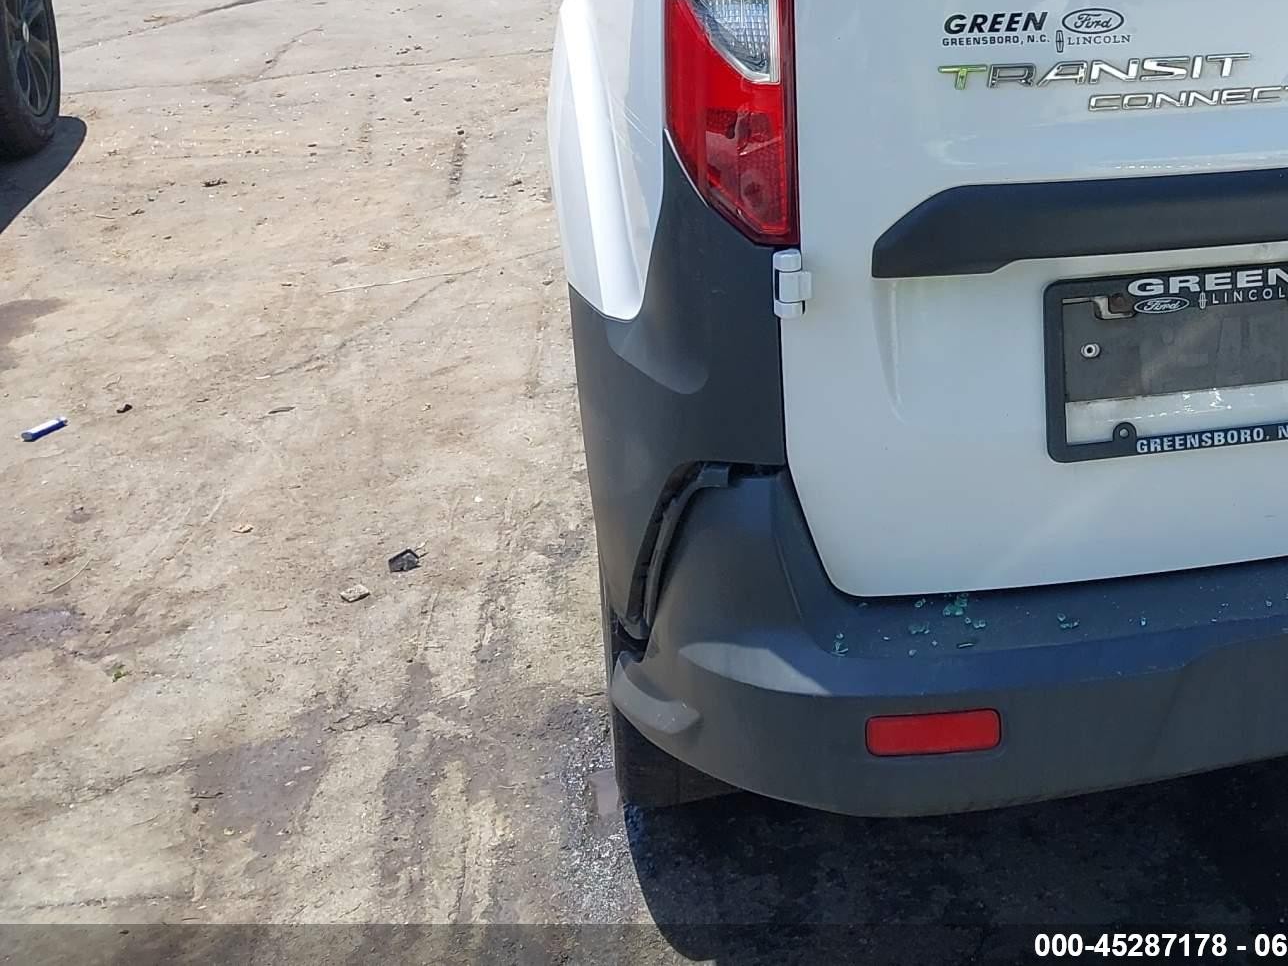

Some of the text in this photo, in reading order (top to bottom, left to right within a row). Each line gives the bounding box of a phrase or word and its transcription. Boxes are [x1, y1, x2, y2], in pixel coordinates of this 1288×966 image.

[944, 12, 1048, 34] GREEN
[1073, 13, 1113, 30] Ford
[942, 34, 1050, 47] GREENSBORO, N.C.
[1067, 34, 1131, 46] LINCOLN
[938, 53, 1252, 90] TRANSIT
[1142, 298, 1182, 312] Ford
